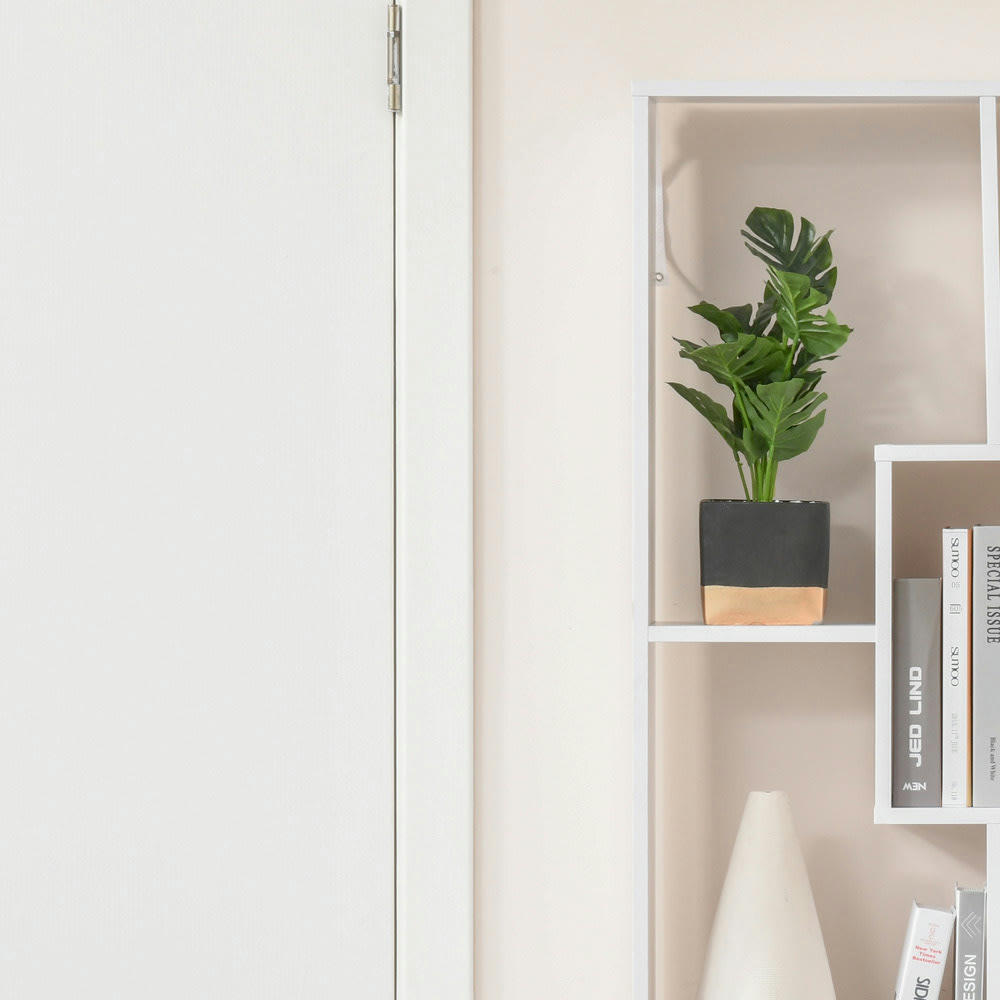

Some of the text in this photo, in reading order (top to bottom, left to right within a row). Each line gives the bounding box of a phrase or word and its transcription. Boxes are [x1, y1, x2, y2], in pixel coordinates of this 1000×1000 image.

[987, 546, 1000, 644] SPECIAL ISSUE
[909, 666, 923, 768] JED LIND
[902, 781, 927, 791] NEW
